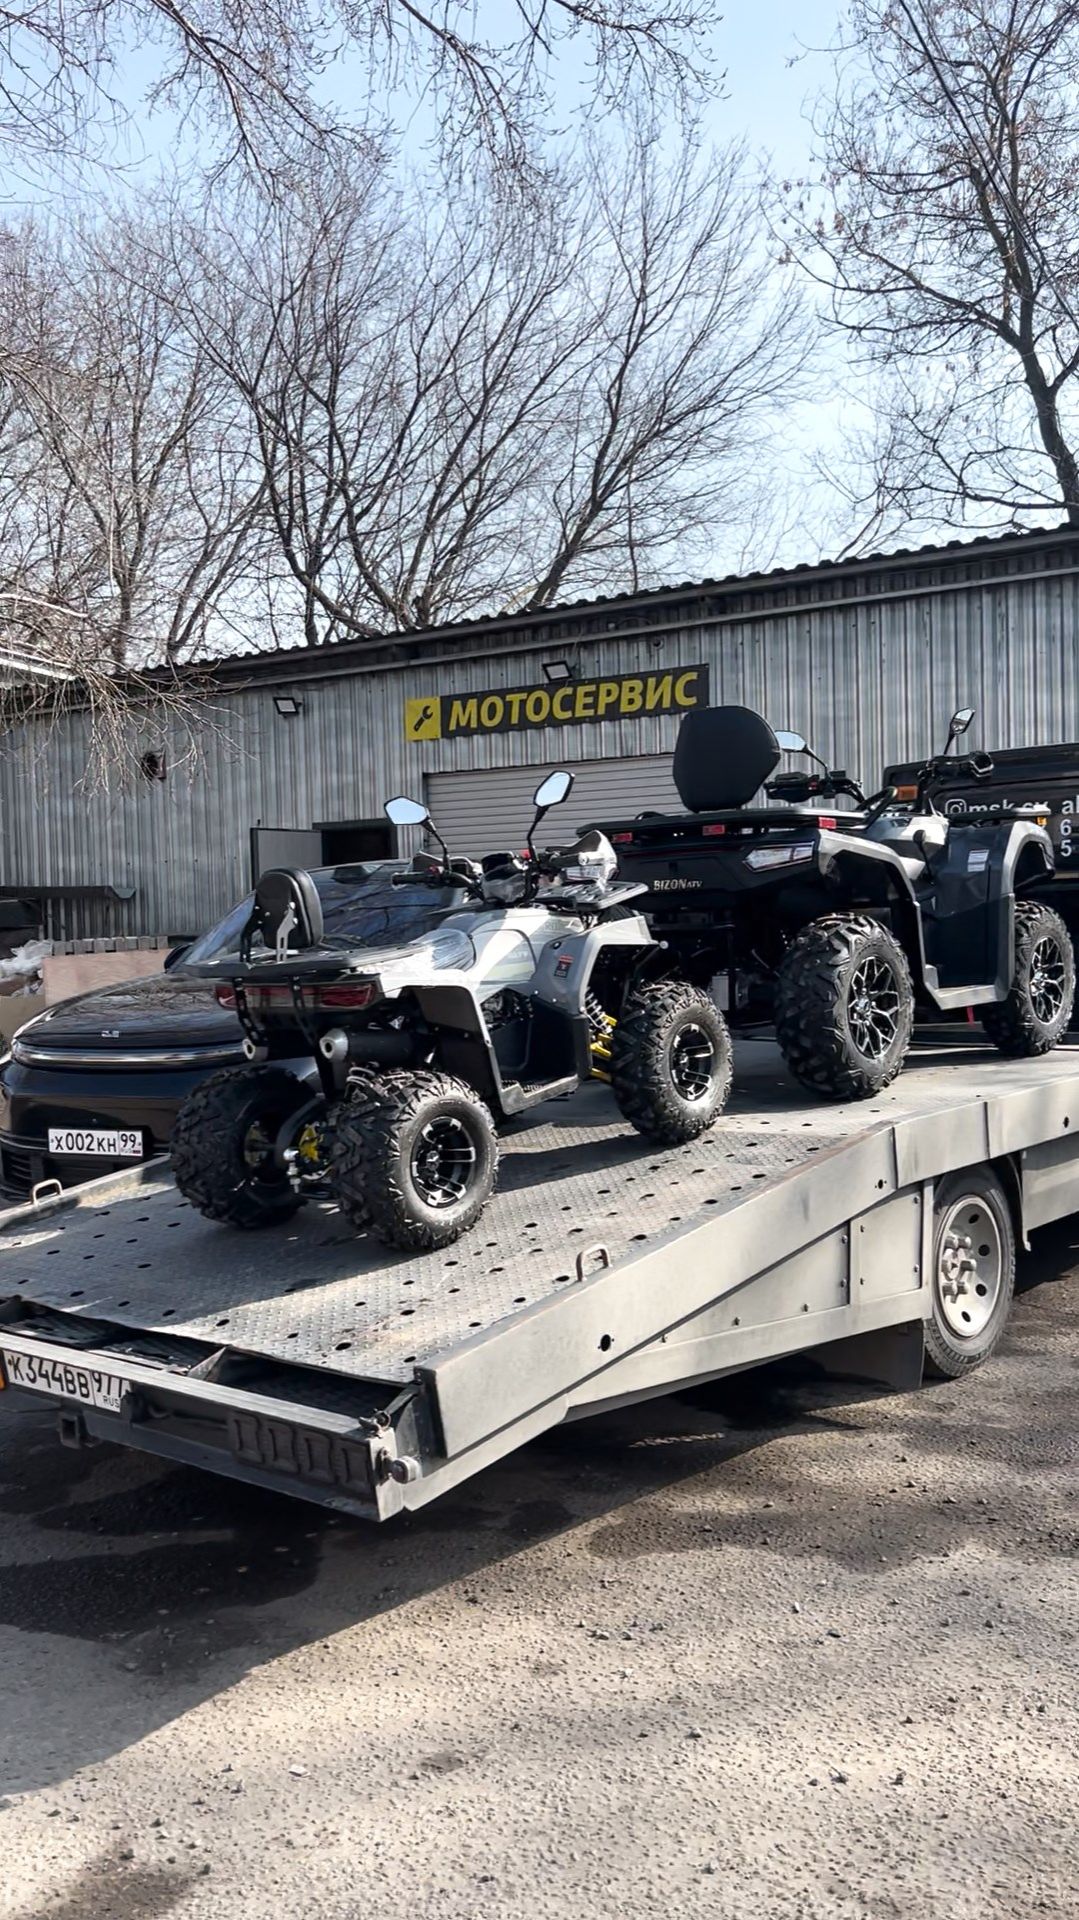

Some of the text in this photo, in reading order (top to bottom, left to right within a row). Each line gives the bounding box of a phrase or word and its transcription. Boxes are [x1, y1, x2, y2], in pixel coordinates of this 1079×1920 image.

[448, 672, 699, 731] МОТОСЕРВИС
[1060, 819, 1072, 836] 6
[1060, 839, 1072, 857] 5
[653, 879, 687, 891] BIZON
[120, 1133, 137, 1148] 99
[102, 1394, 120, 1408] RUS
